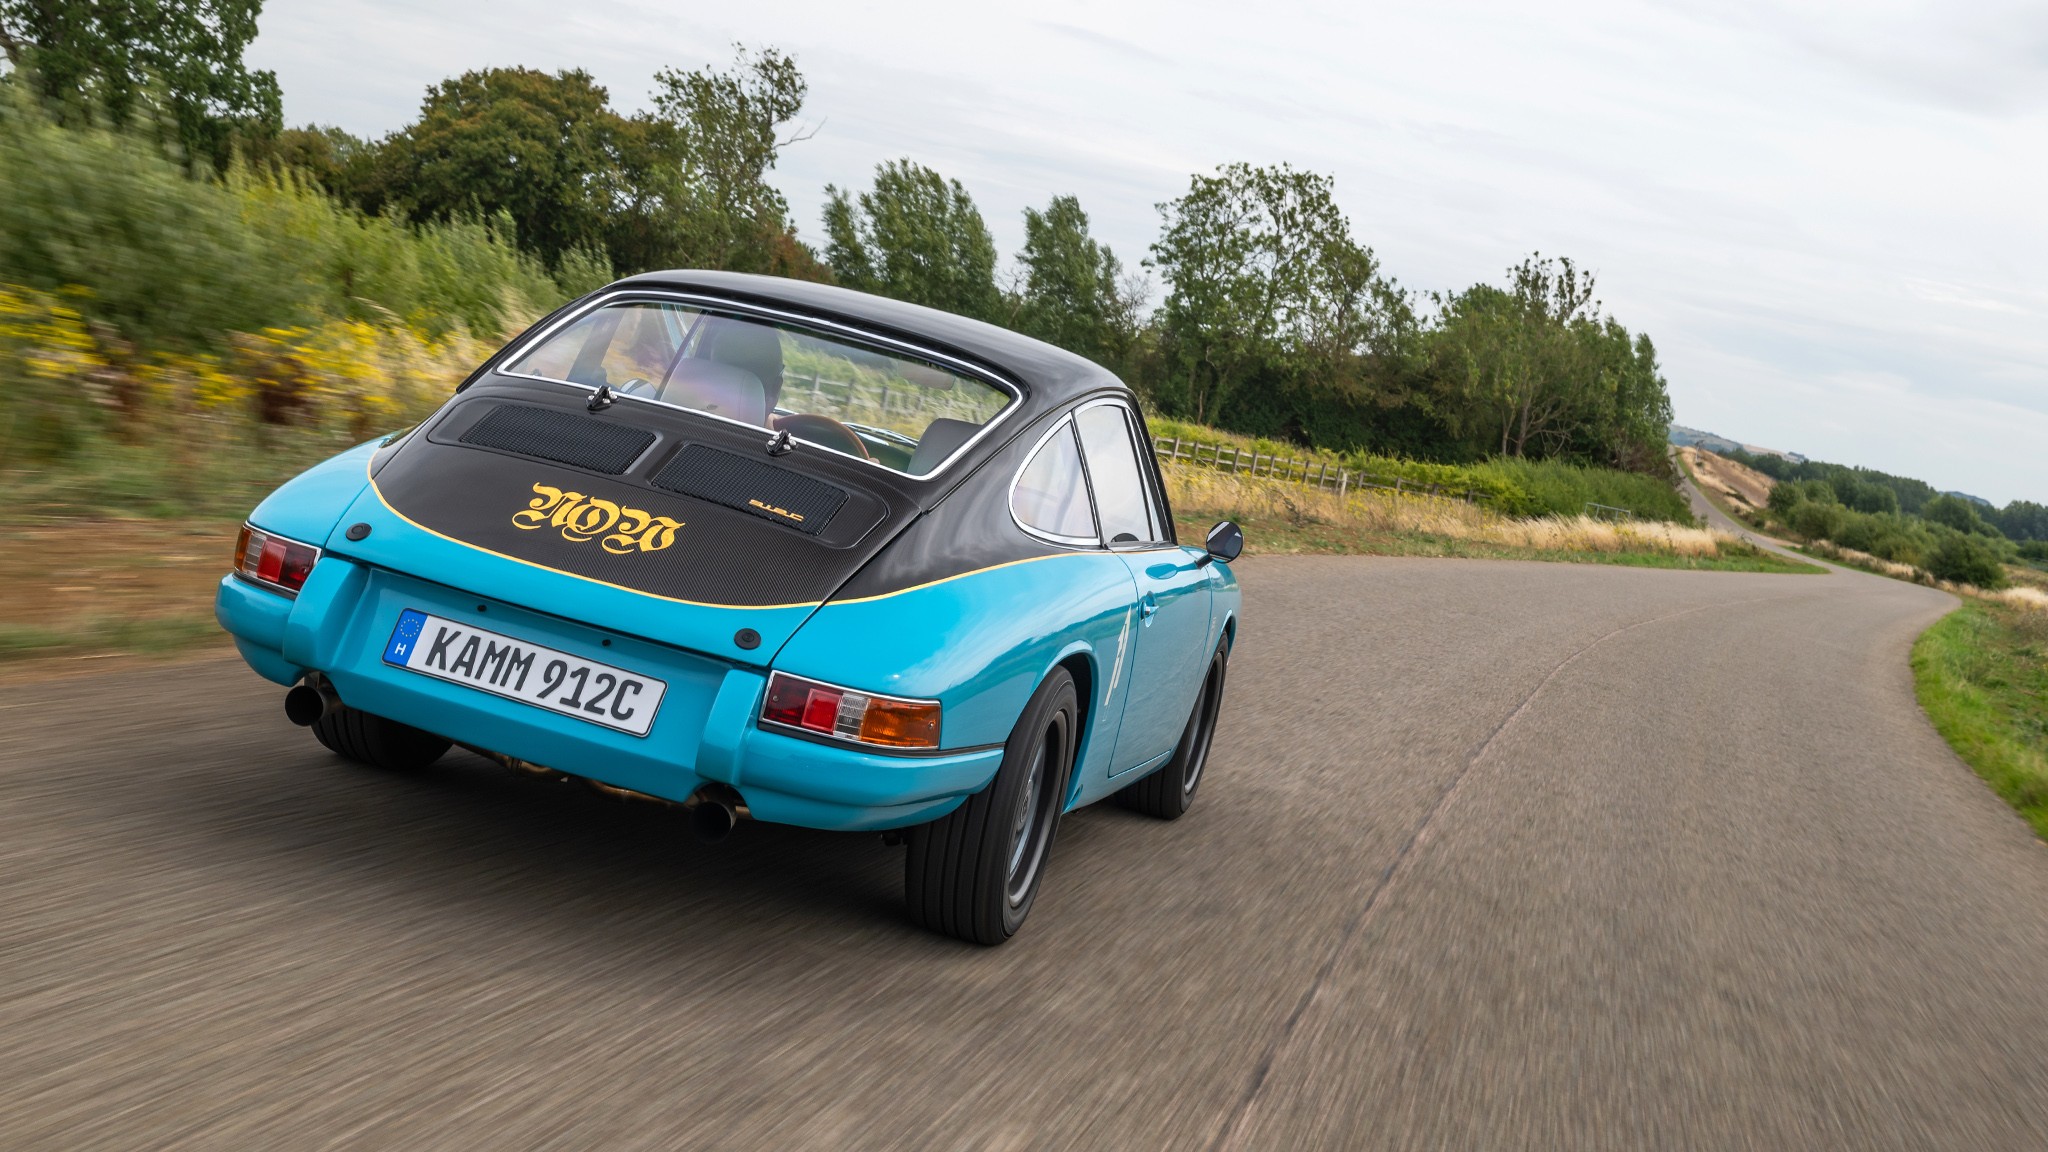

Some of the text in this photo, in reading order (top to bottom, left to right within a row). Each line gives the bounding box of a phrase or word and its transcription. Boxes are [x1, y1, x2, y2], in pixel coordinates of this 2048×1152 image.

[394, 642, 407, 656] H
[425, 626, 643, 721] KAMM 912C
